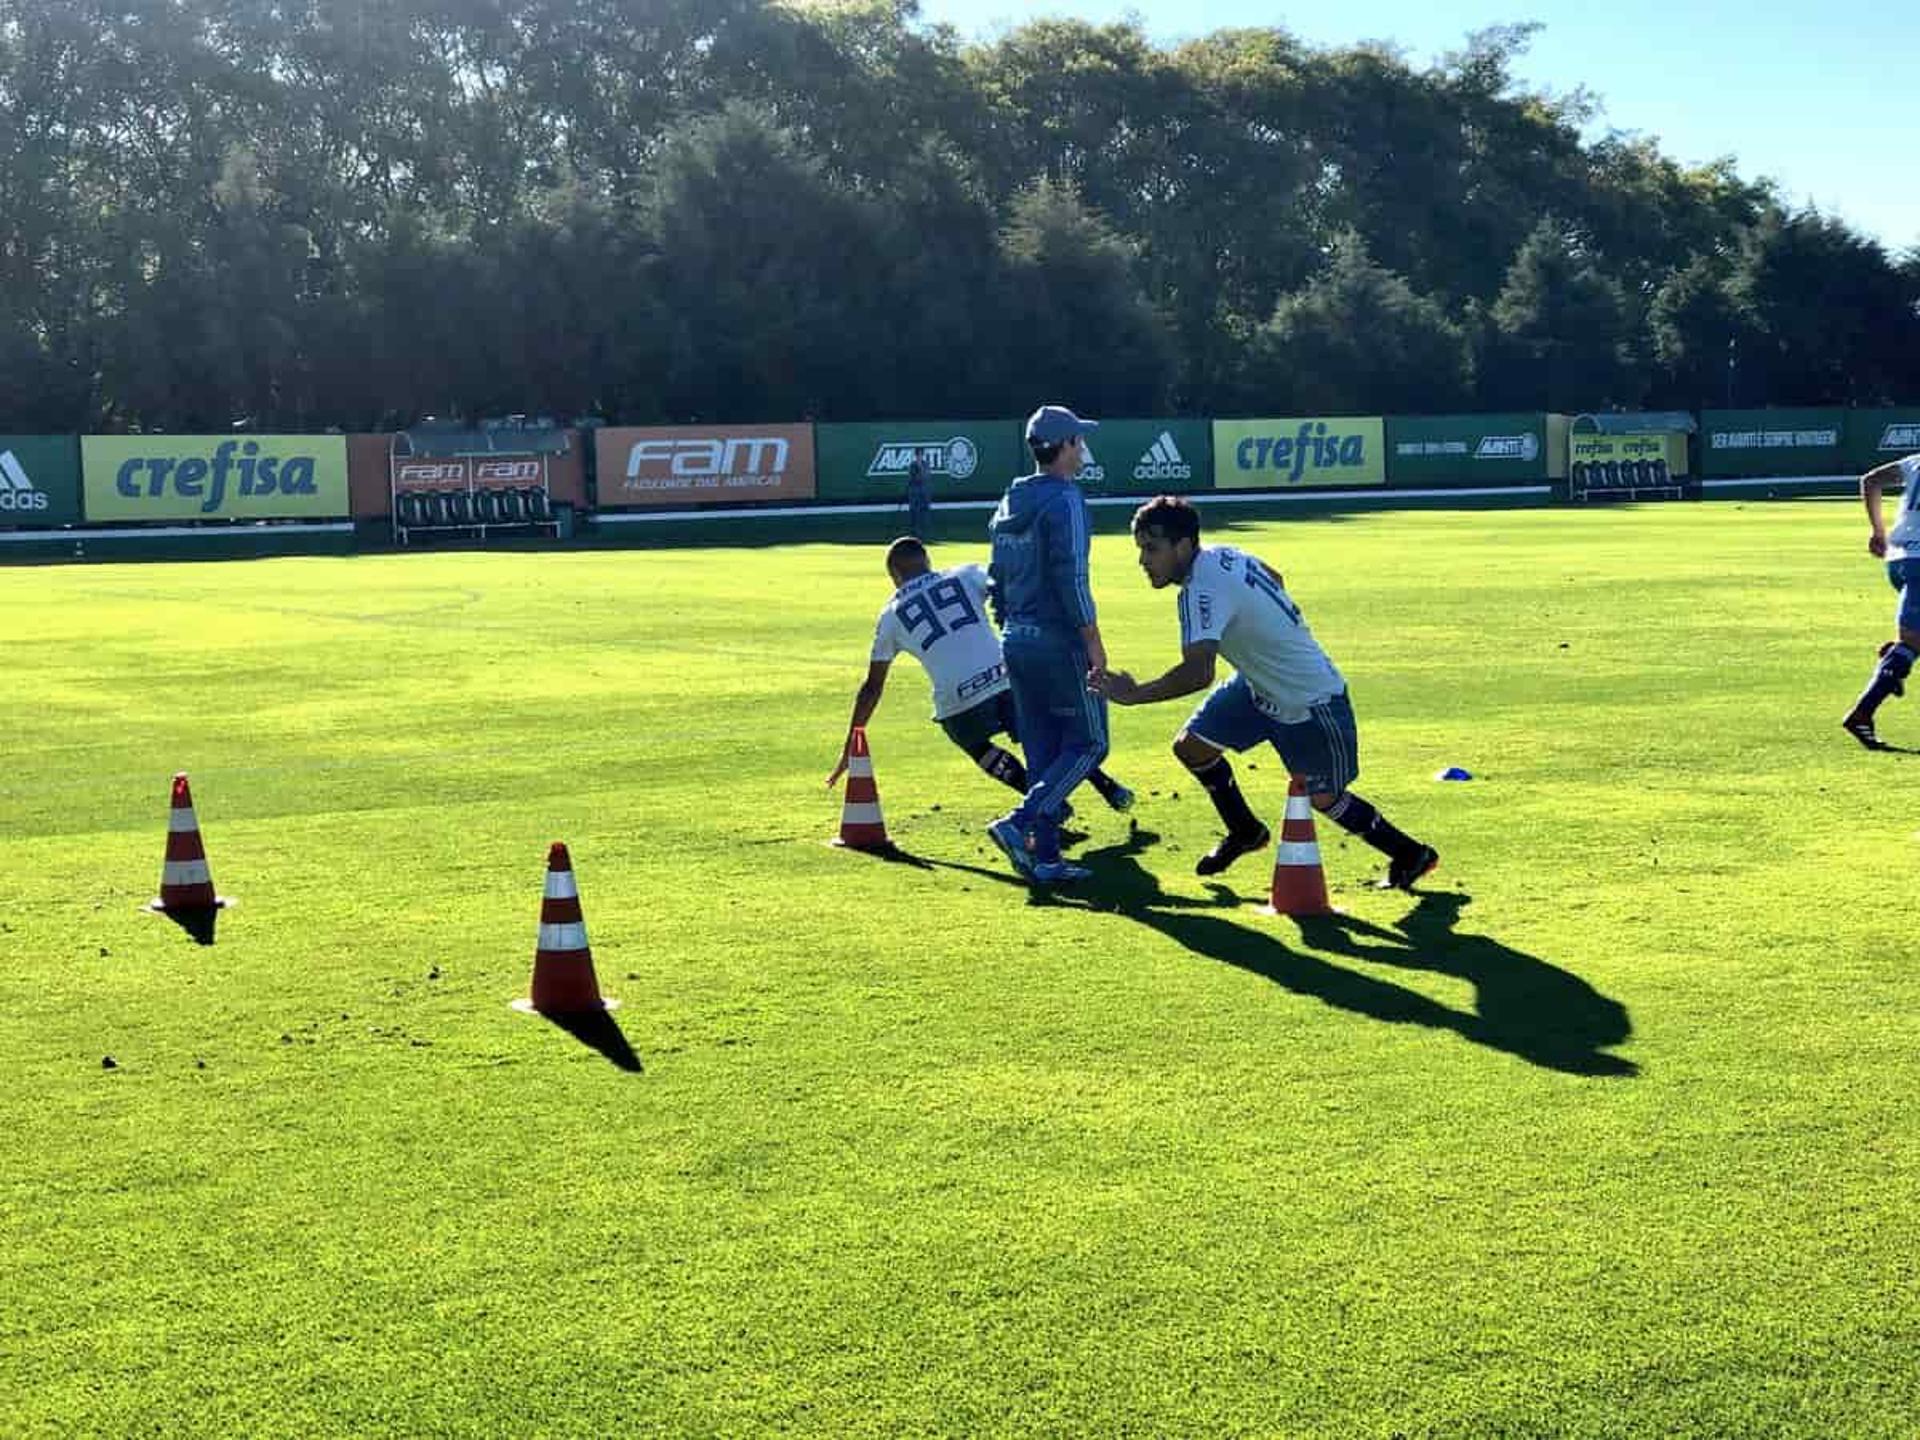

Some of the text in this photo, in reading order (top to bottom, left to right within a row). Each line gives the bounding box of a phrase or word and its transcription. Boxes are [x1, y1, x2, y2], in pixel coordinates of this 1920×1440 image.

[117, 440, 318, 512] crefisa
[1133, 461, 1191, 479] adidas
[1237, 422, 1365, 481] crefisa
[896, 577, 979, 651] 99
